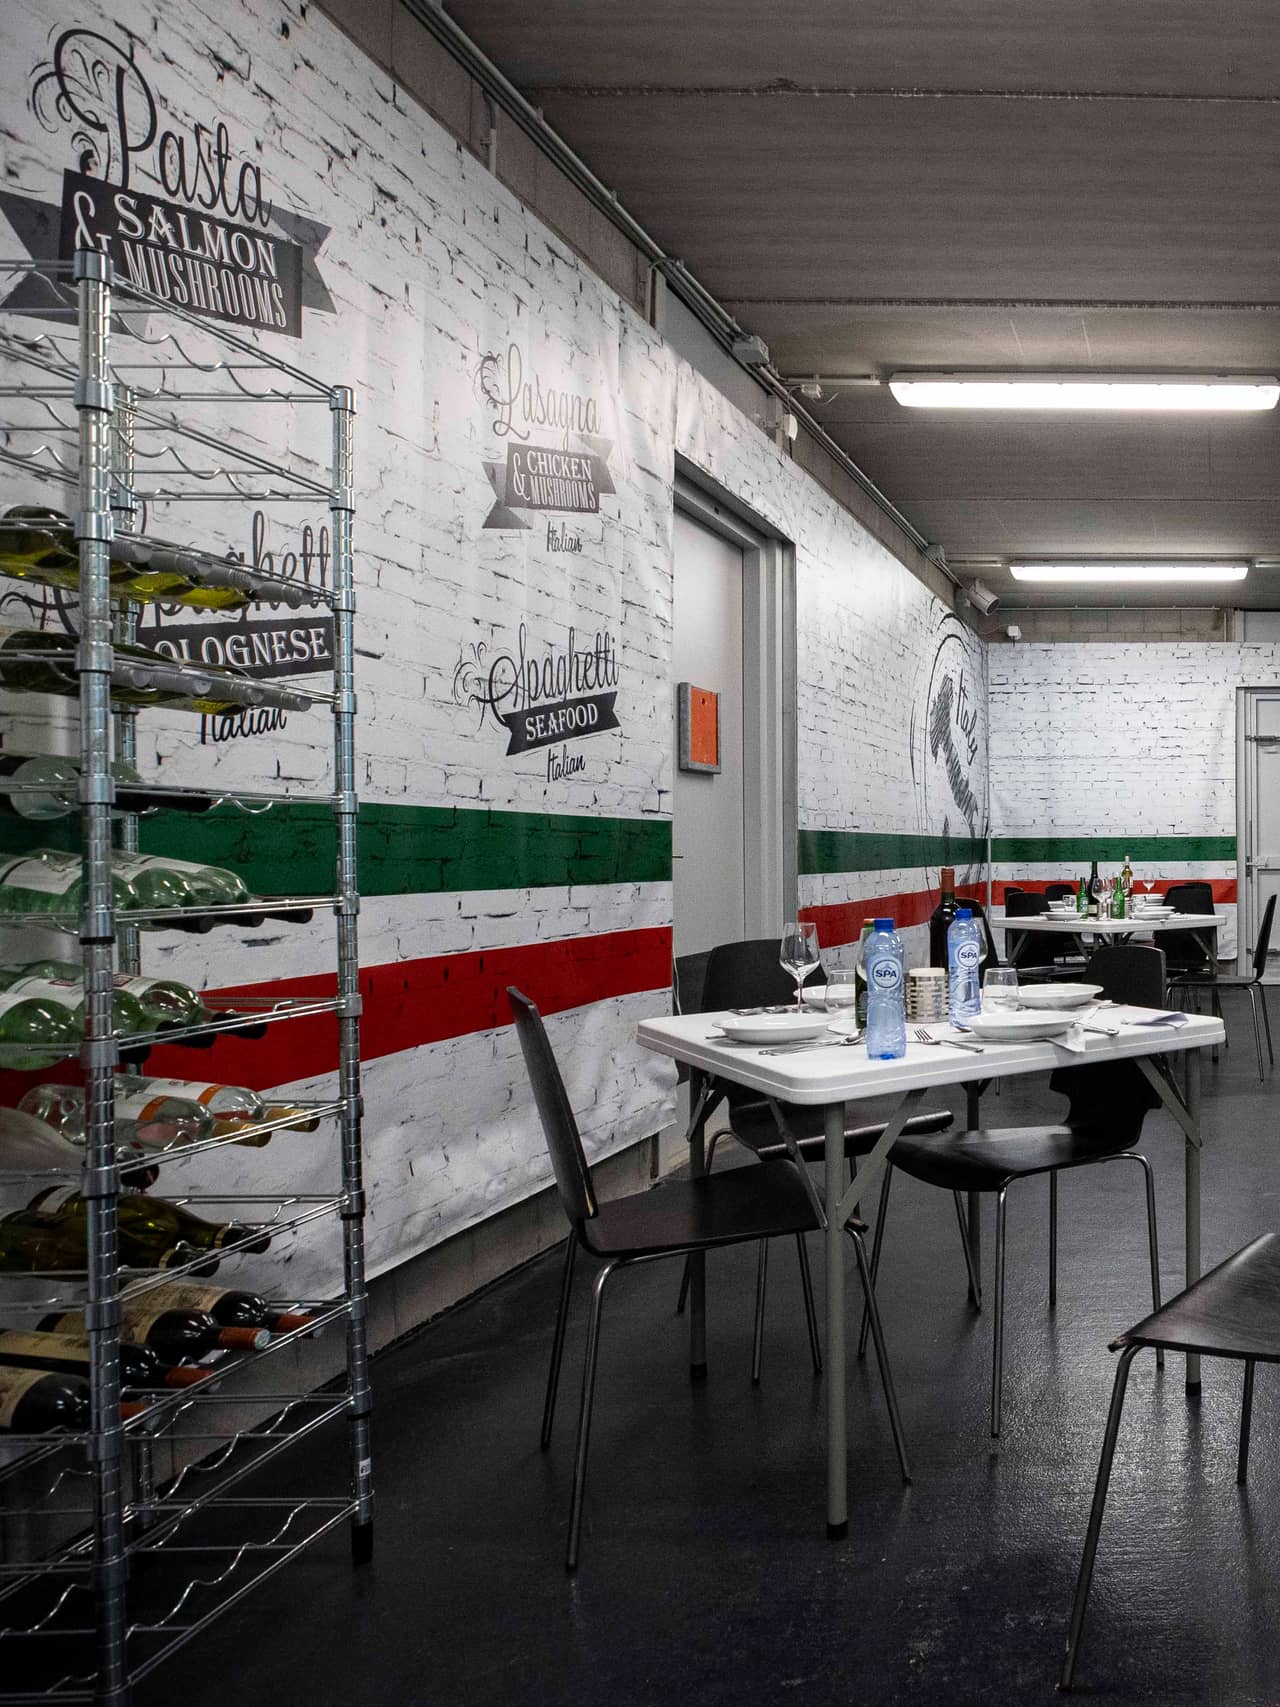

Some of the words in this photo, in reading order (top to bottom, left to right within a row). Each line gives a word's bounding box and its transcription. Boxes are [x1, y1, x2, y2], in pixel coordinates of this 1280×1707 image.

[53, 28, 272, 227] Pasta
[113, 192, 279, 280] SALMON
[121, 238, 288, 328] MUSHROOMS
[478, 342, 600, 450] Lasagna
[526, 450, 593, 482] CHICKEN
[529, 475, 597, 509] MUSHROOMS
[546, 520, 583, 553] Italian
[137, 626, 332, 668] OLOGNESE
[489, 622, 620, 712] Spaghetti
[525, 703, 599, 742] SEAFOOD
[955, 668, 979, 766] Italy
[547, 743, 586, 783] Italian
[875, 968, 898, 979] SPA
[960, 951, 978, 960] SPA
